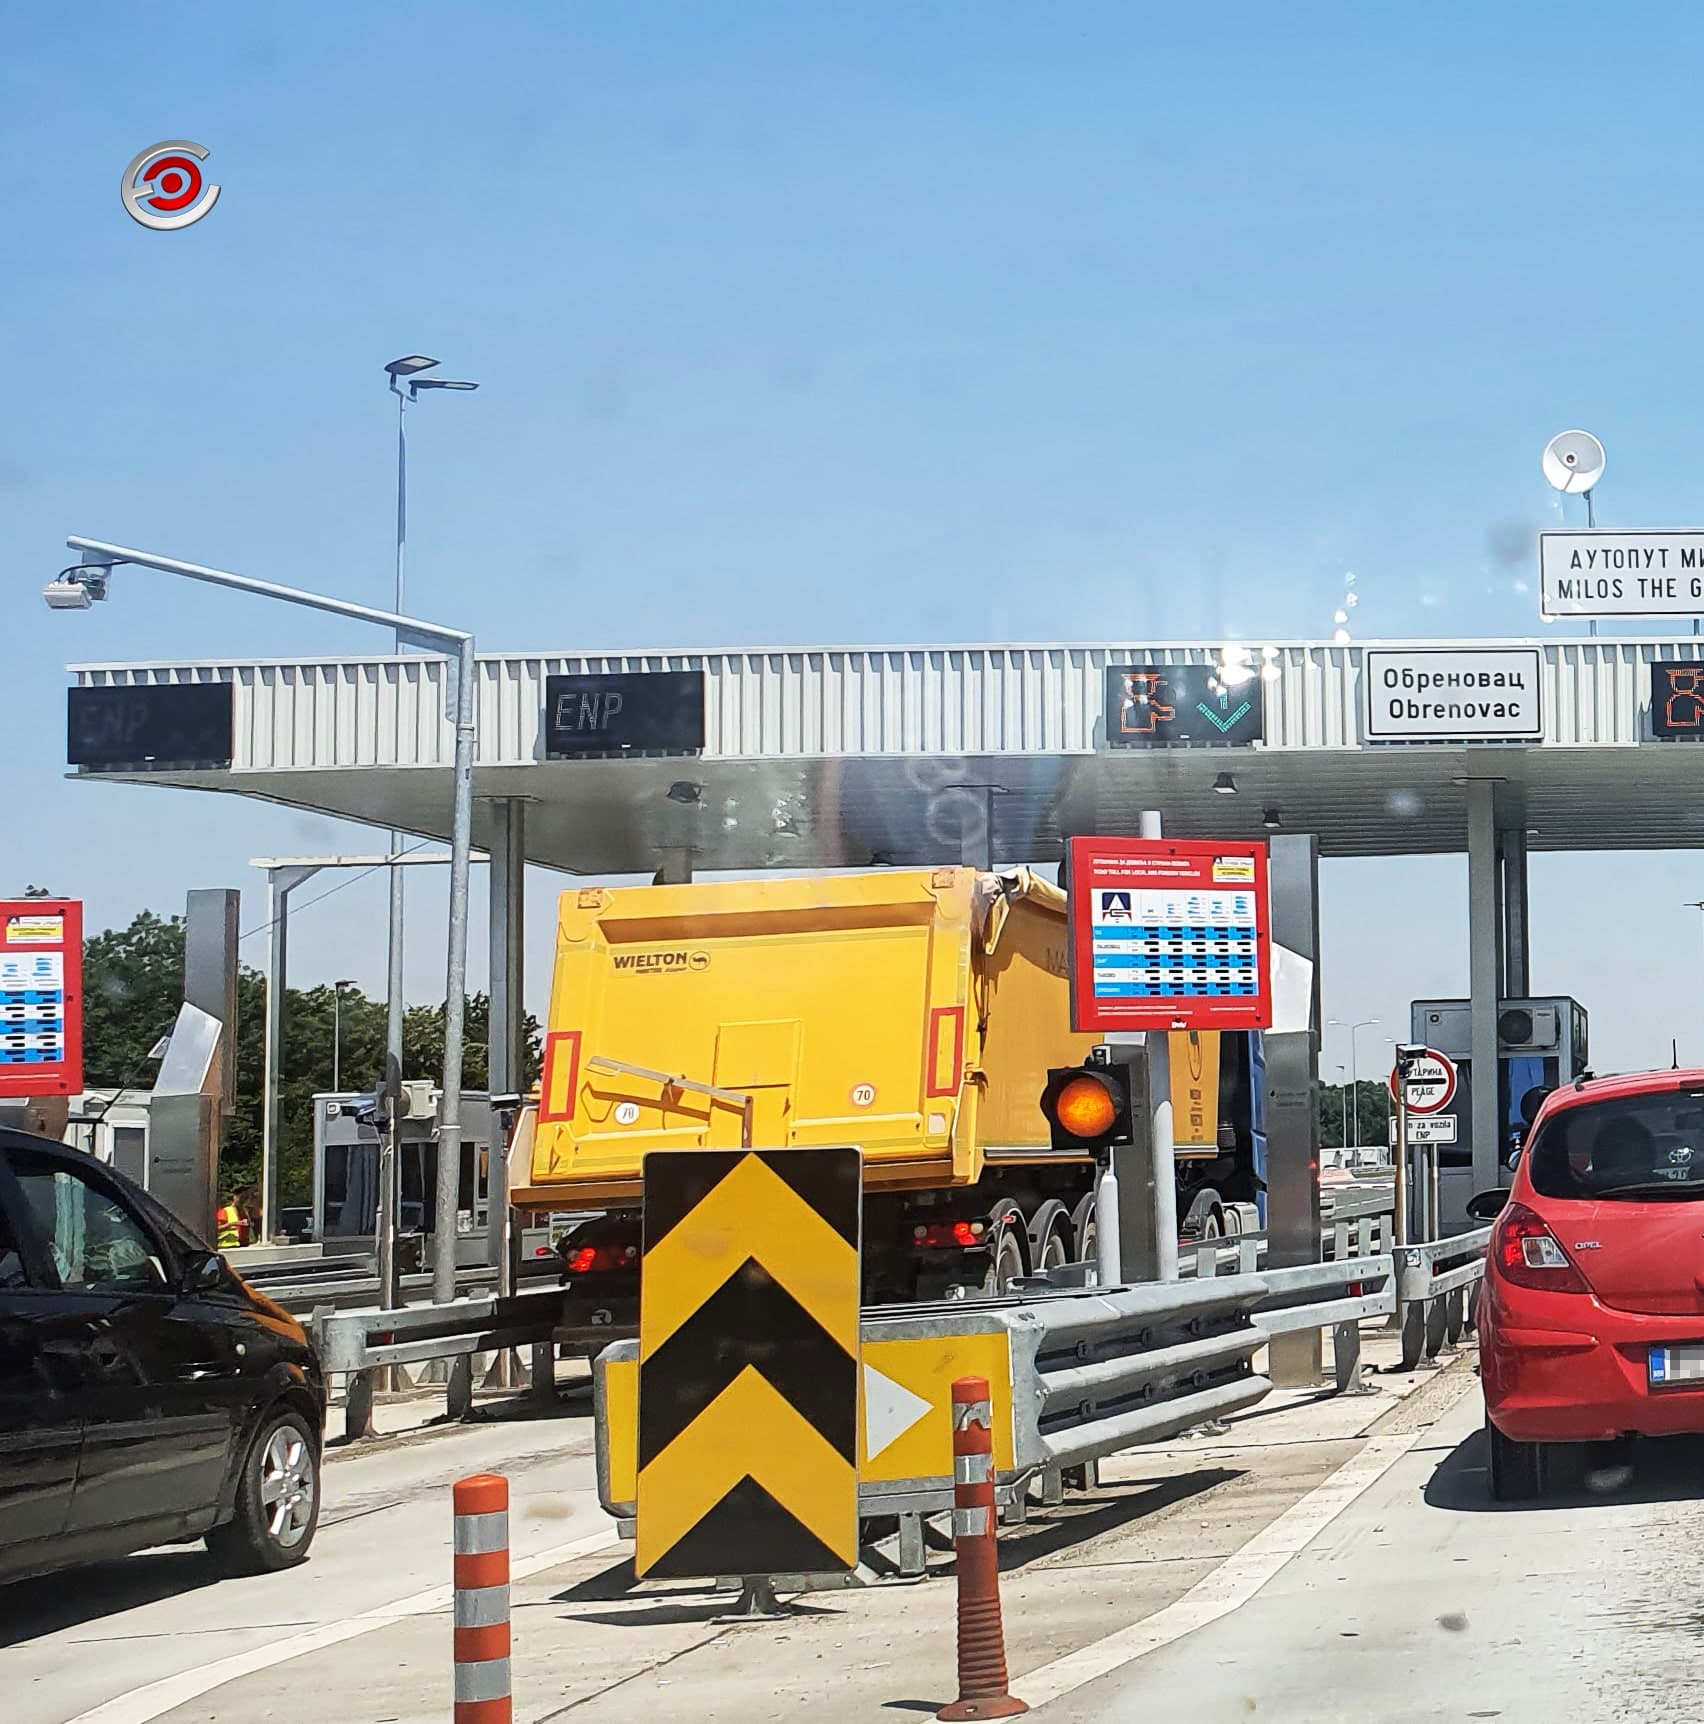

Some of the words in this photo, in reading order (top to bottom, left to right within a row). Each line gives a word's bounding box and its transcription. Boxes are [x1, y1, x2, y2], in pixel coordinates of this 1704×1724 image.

[1570, 548, 1669, 569] АУТОПУТ
[1558, 578, 1623, 599] MILOS
[1637, 578, 1677, 598] THE
[1383, 668, 1525, 694] Обреновац
[554, 693, 623, 731] ENP
[1389, 698, 1520, 719] Obrenovac
[613, 952, 688, 969] WIELTON
[857, 1090, 871, 1101] 70
